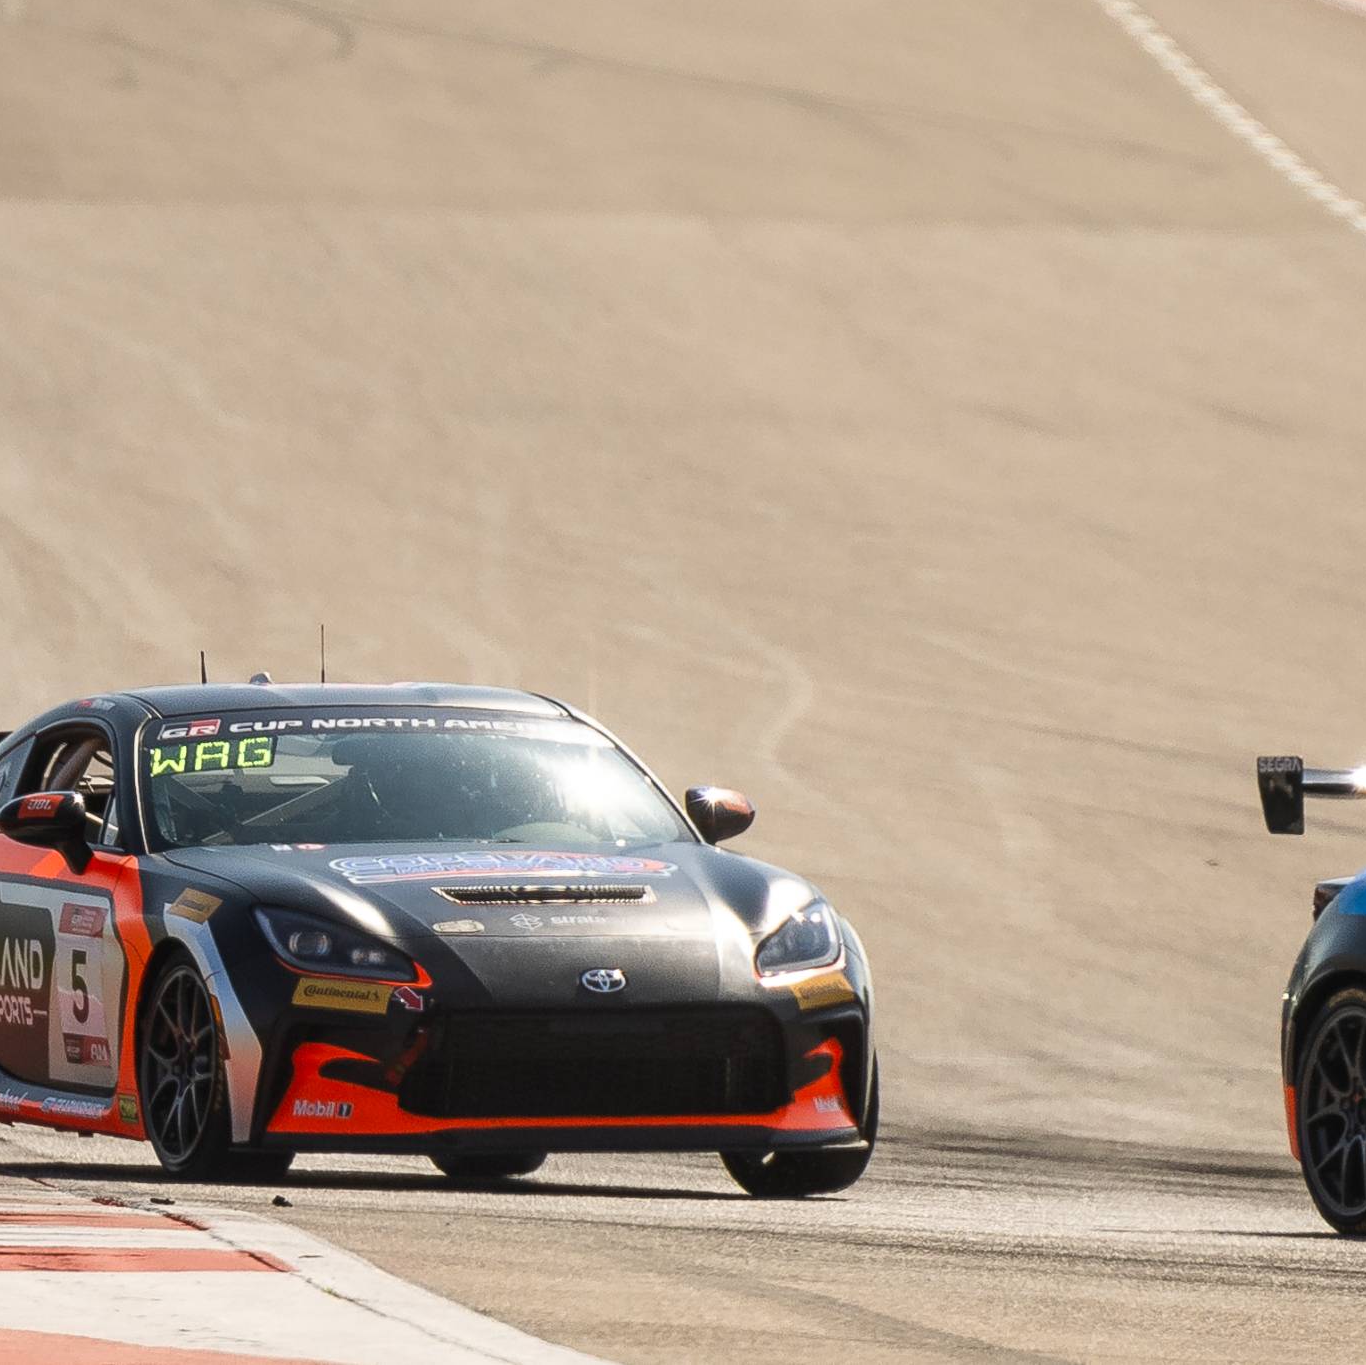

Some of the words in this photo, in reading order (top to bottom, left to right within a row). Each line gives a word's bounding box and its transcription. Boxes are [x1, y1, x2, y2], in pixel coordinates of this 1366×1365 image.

[161, 722, 219, 739] GR
[229, 719, 304, 733] CUP
[311, 717, 436, 730] NORTH
[150, 736, 273, 776] WAG
[72, 949, 90, 1024] 5
[303, 984, 371, 1001] Continental
[91, 1042, 110, 1062] AM
[293, 1099, 335, 1118] Mobil
[339, 1102, 352, 1117] 1
